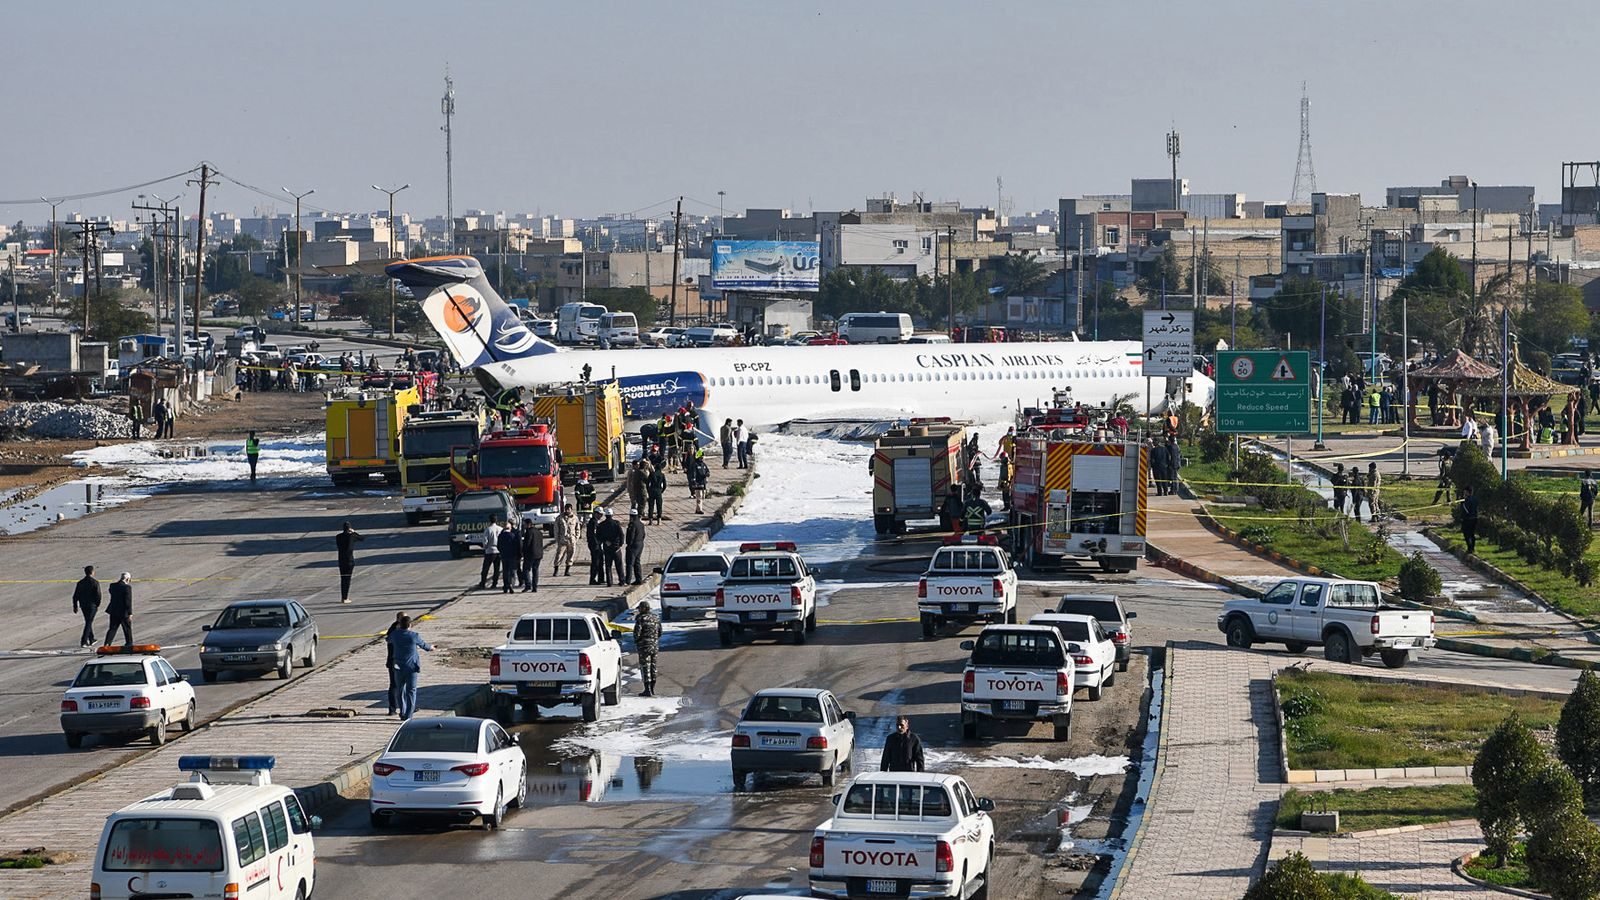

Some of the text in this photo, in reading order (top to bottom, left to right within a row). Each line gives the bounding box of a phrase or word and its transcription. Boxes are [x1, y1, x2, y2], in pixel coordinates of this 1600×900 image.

[1148, 324, 1190, 334] مرکز شهر
[916, 353, 1064, 368] CASPIAN AIRLINES
[733, 362, 773, 372] EP-CPZ
[1237, 368, 1248, 376] 50
[619, 383, 667, 394] CDONNELL
[620, 389, 662, 400] OUGLAS
[1237, 403, 1289, 412] Reduce Speed
[1221, 418, 1235, 426] 100
[936, 586, 983, 596] TOYOTA
[734, 594, 781, 604] TOYOTA
[512, 662, 567, 673] TOYOTA
[987, 679, 1044, 691] TOYOTA
[841, 850, 919, 866] TOYOTA
